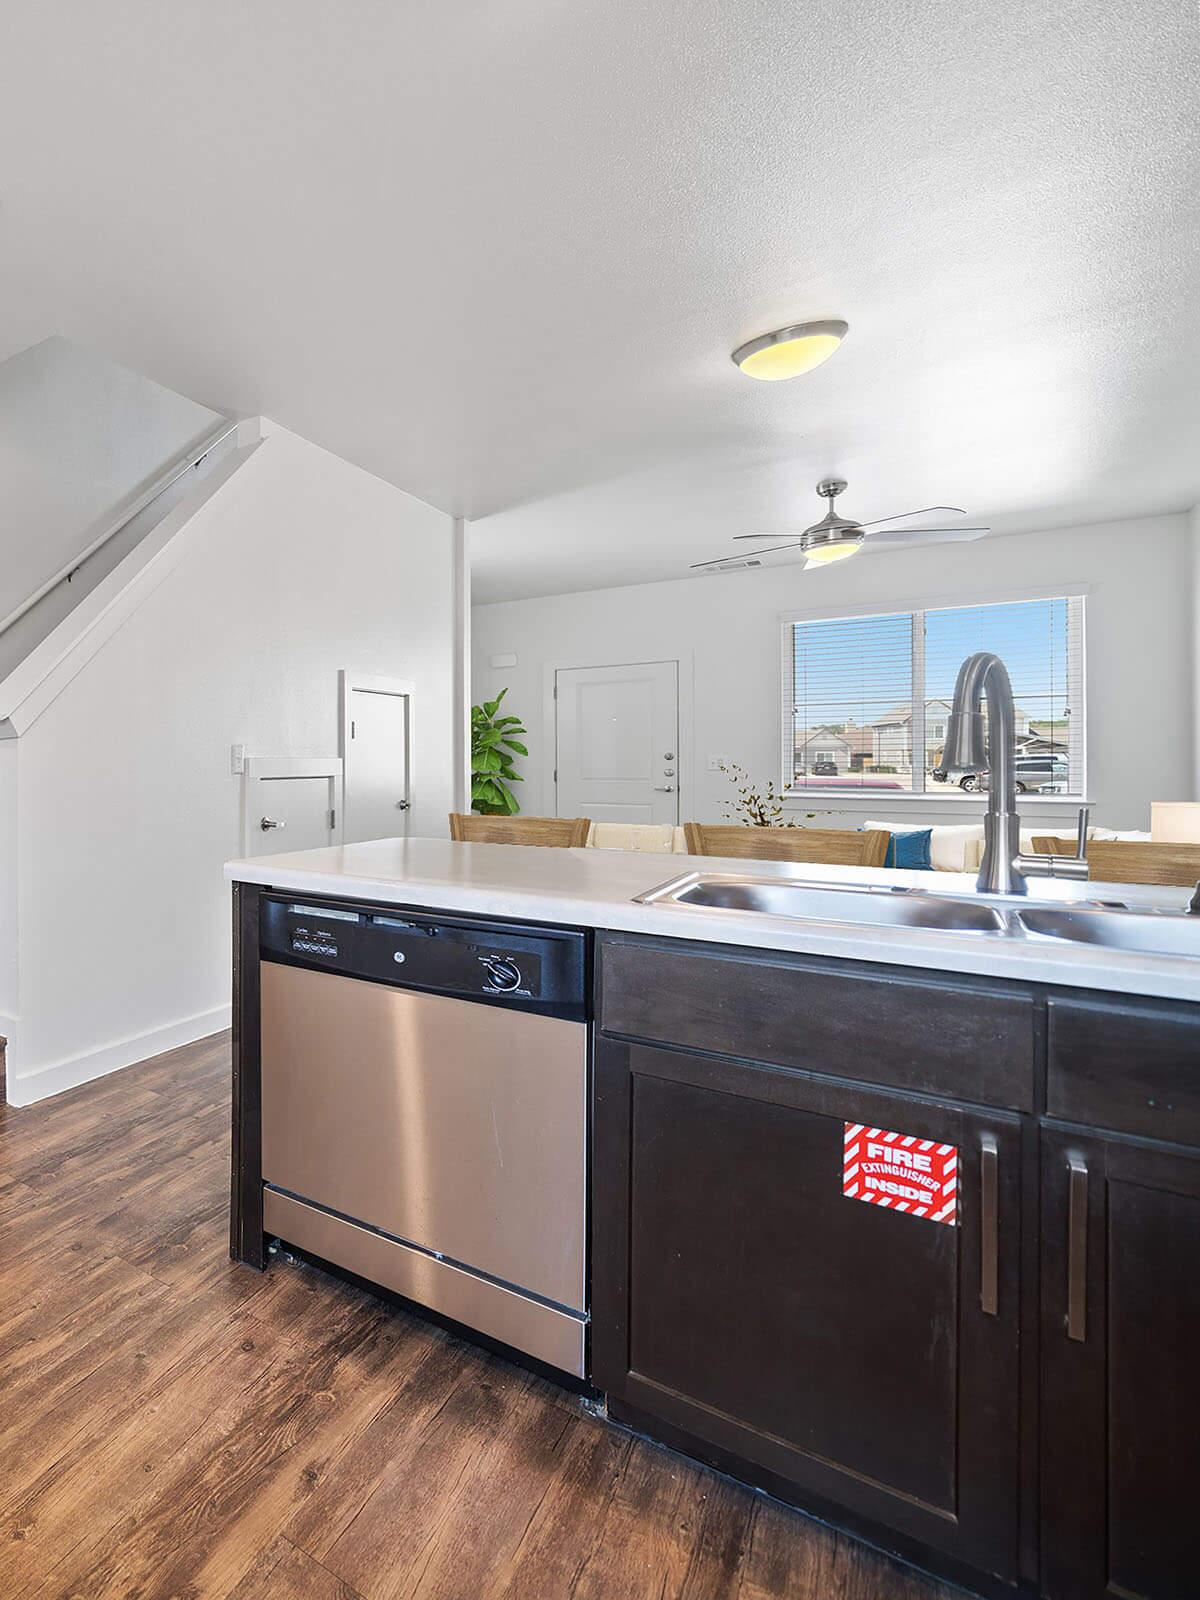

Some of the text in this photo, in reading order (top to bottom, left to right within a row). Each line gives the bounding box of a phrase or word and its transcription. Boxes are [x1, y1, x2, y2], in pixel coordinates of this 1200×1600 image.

[867, 1143, 931, 1172] FIRE
[861, 1162, 941, 1191] EXTINGUISHER
[864, 1176, 933, 1204] INSIDE
